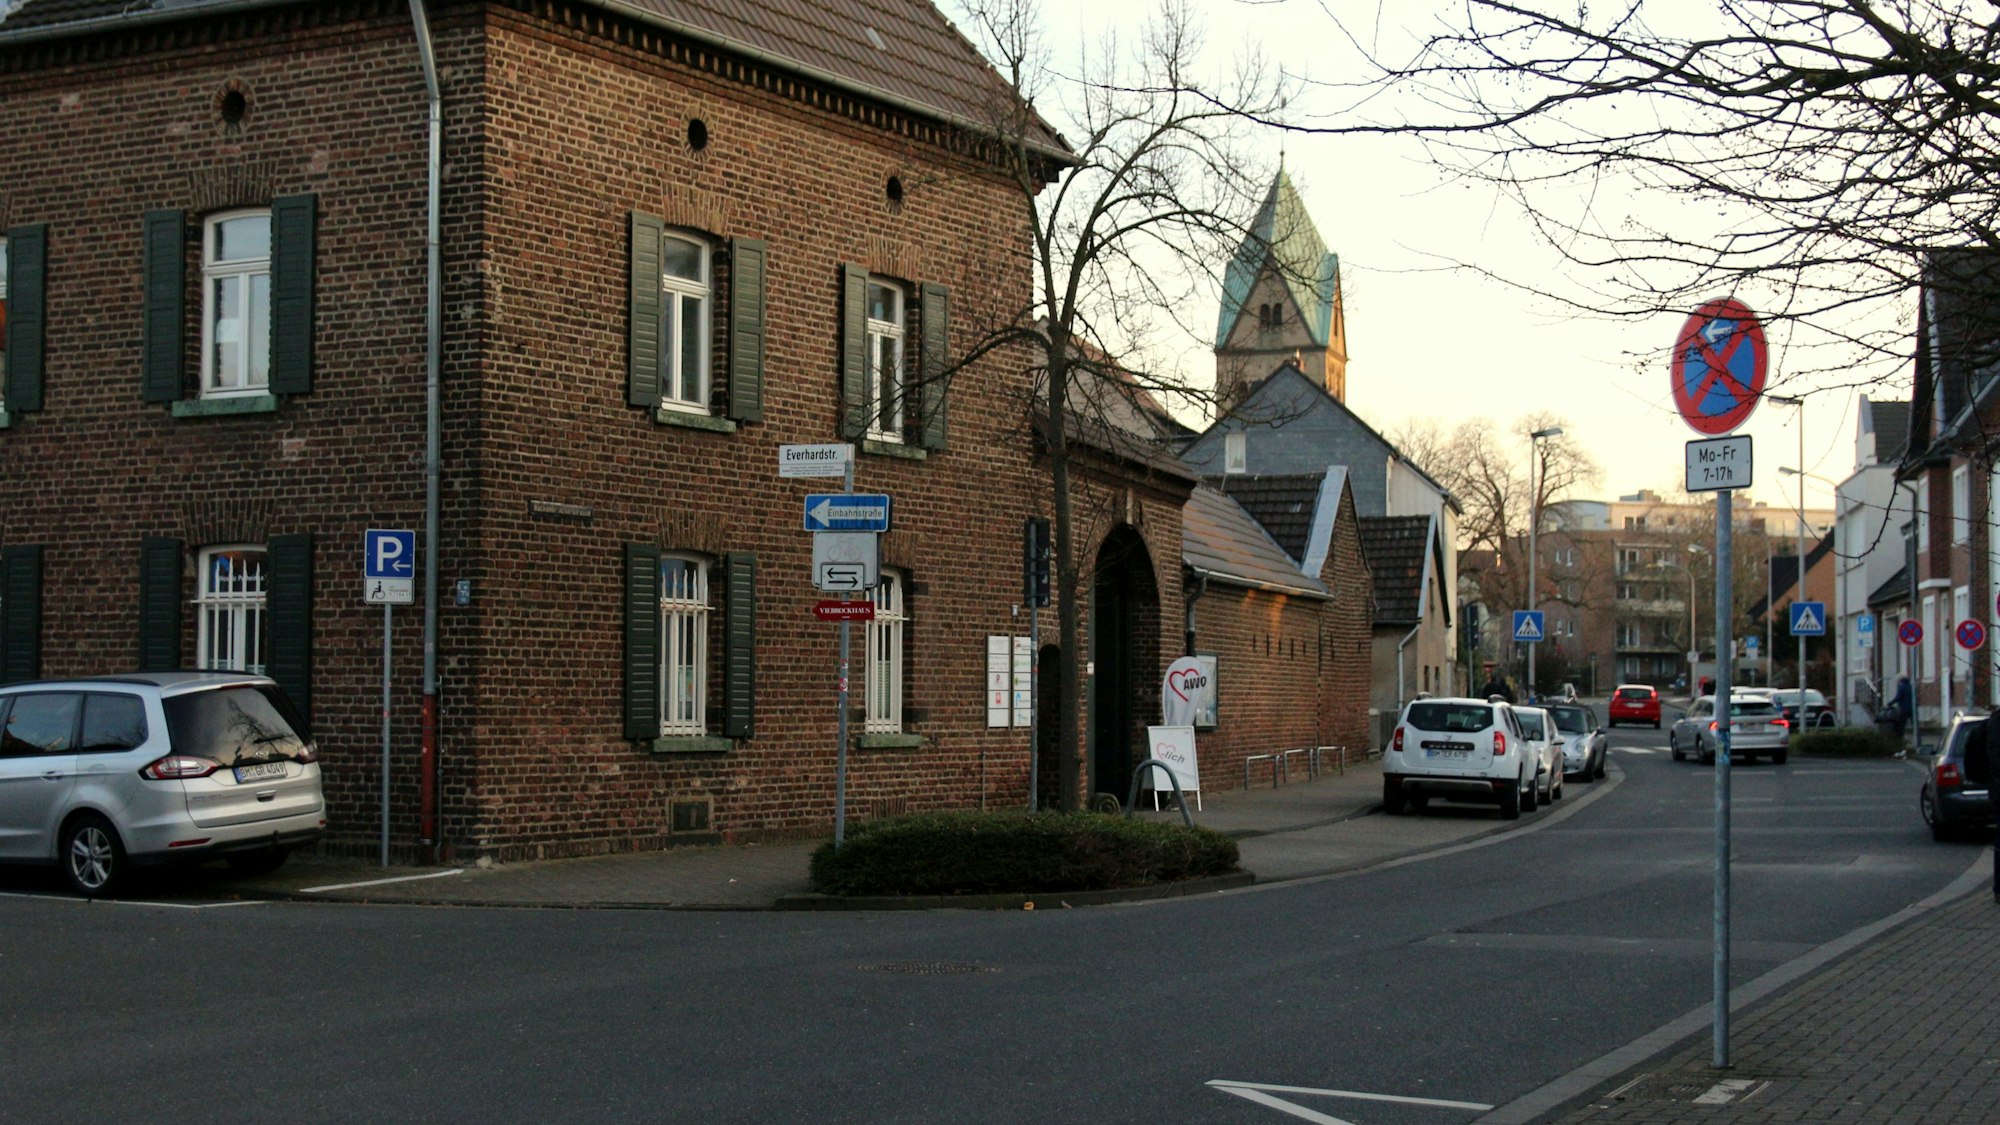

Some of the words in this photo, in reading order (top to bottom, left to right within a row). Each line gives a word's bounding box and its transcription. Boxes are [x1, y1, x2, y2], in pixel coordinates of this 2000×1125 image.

[786, 448, 838, 461] Everhardstr.
[1698, 445, 1737, 463] Mo-Fr
[1703, 466, 1733, 482] 7-17h
[827, 508, 883, 520] Einbahnstraße
[376, 536, 403, 572] P
[1860, 617, 1870, 630] P
[1183, 676, 1207, 691] AWO
